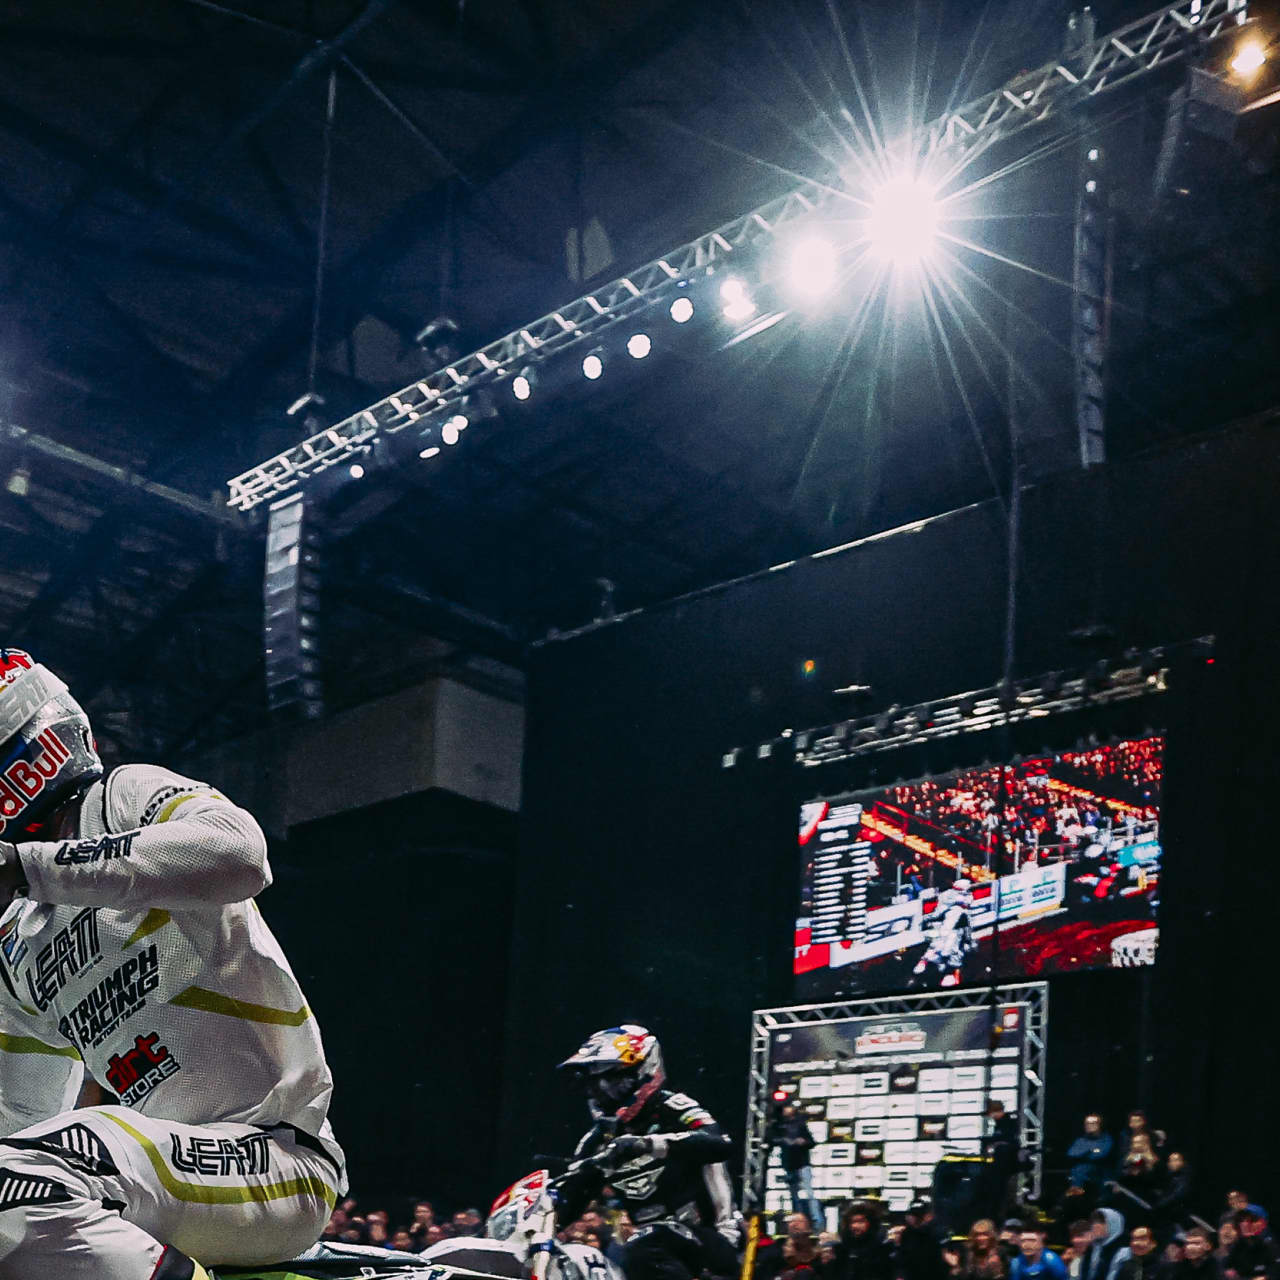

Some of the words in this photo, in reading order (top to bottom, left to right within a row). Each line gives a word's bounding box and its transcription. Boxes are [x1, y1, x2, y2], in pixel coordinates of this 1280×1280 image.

[5, 727, 71, 800] Bull
[69, 943, 158, 1029] TRIUMPH
[78, 968, 160, 1050] RACING
[120, 1057, 180, 1107] STORE
